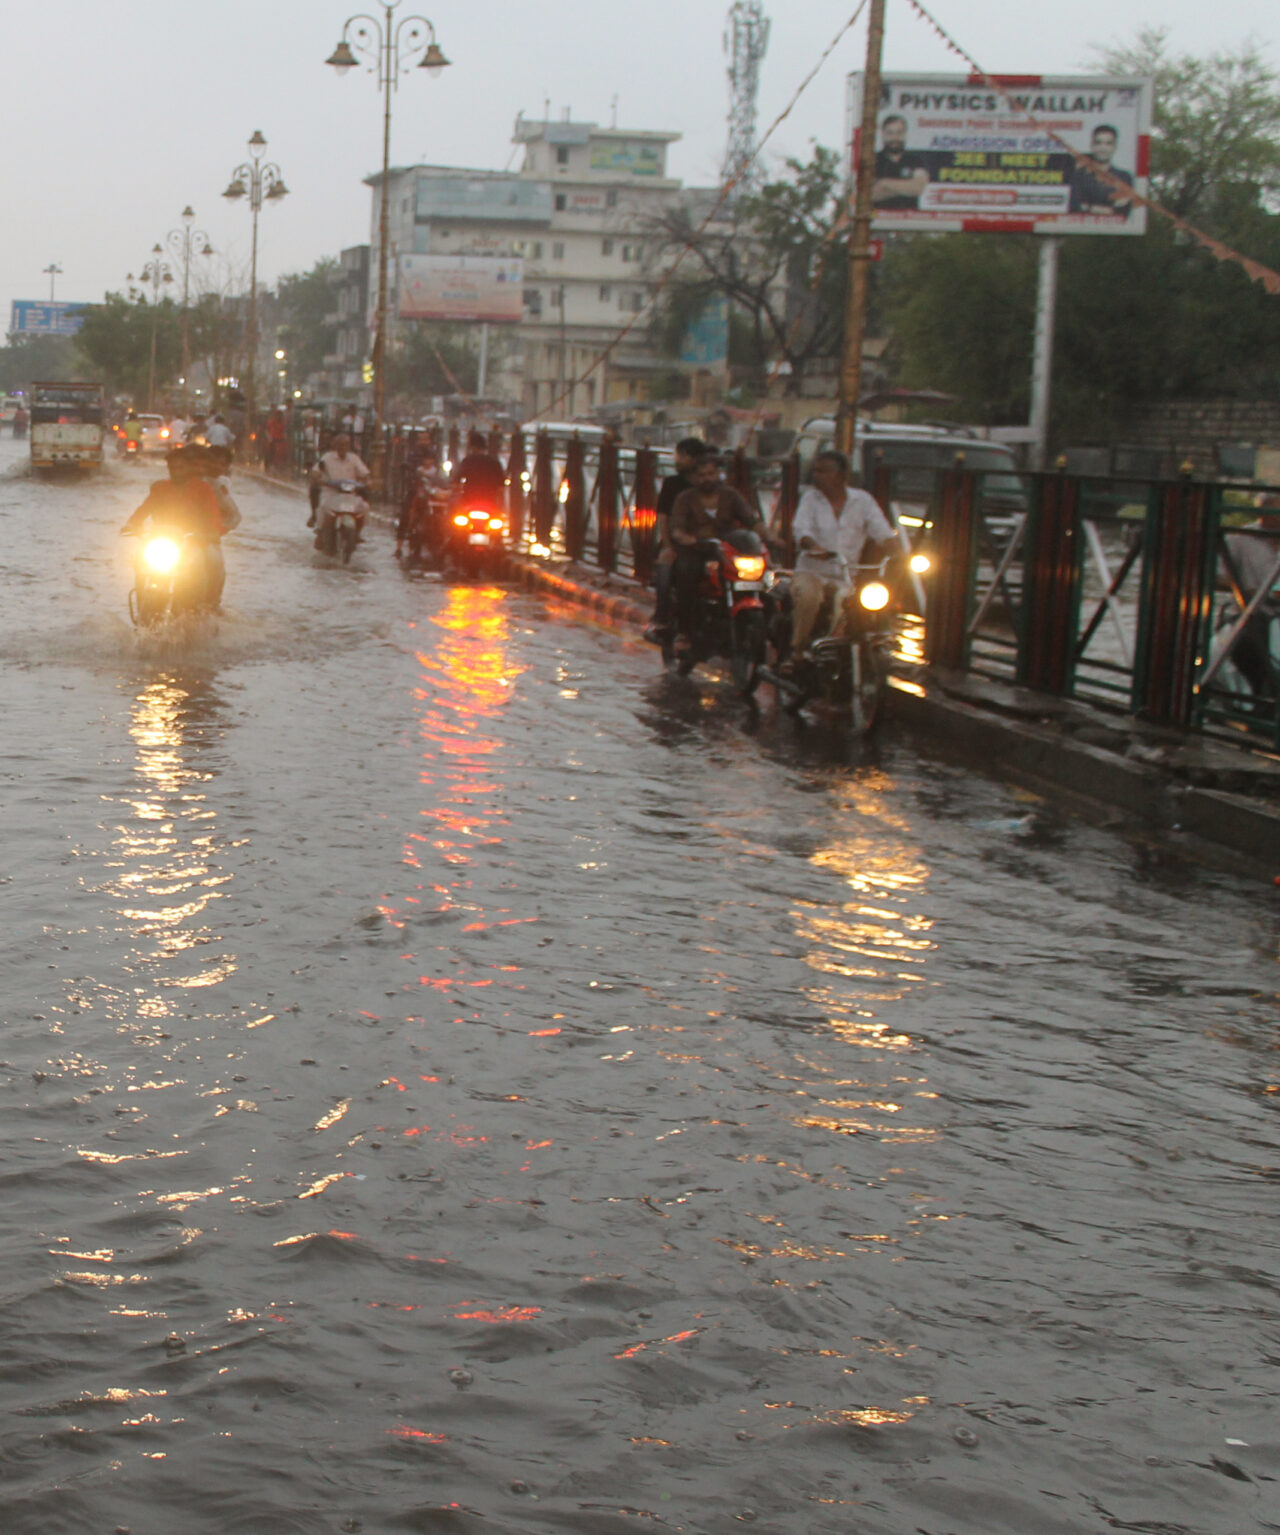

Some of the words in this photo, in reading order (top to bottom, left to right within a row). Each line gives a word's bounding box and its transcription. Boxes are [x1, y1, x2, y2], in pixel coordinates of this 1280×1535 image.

[899, 93, 997, 112] PHYSICS
[1007, 94, 1107, 113] WALLAH
[931, 136, 1018, 150] ADMISSION
[953, 152, 986, 166] JEE
[1000, 153, 1050, 167] NEET
[939, 168, 1063, 184] FOUNDATION
